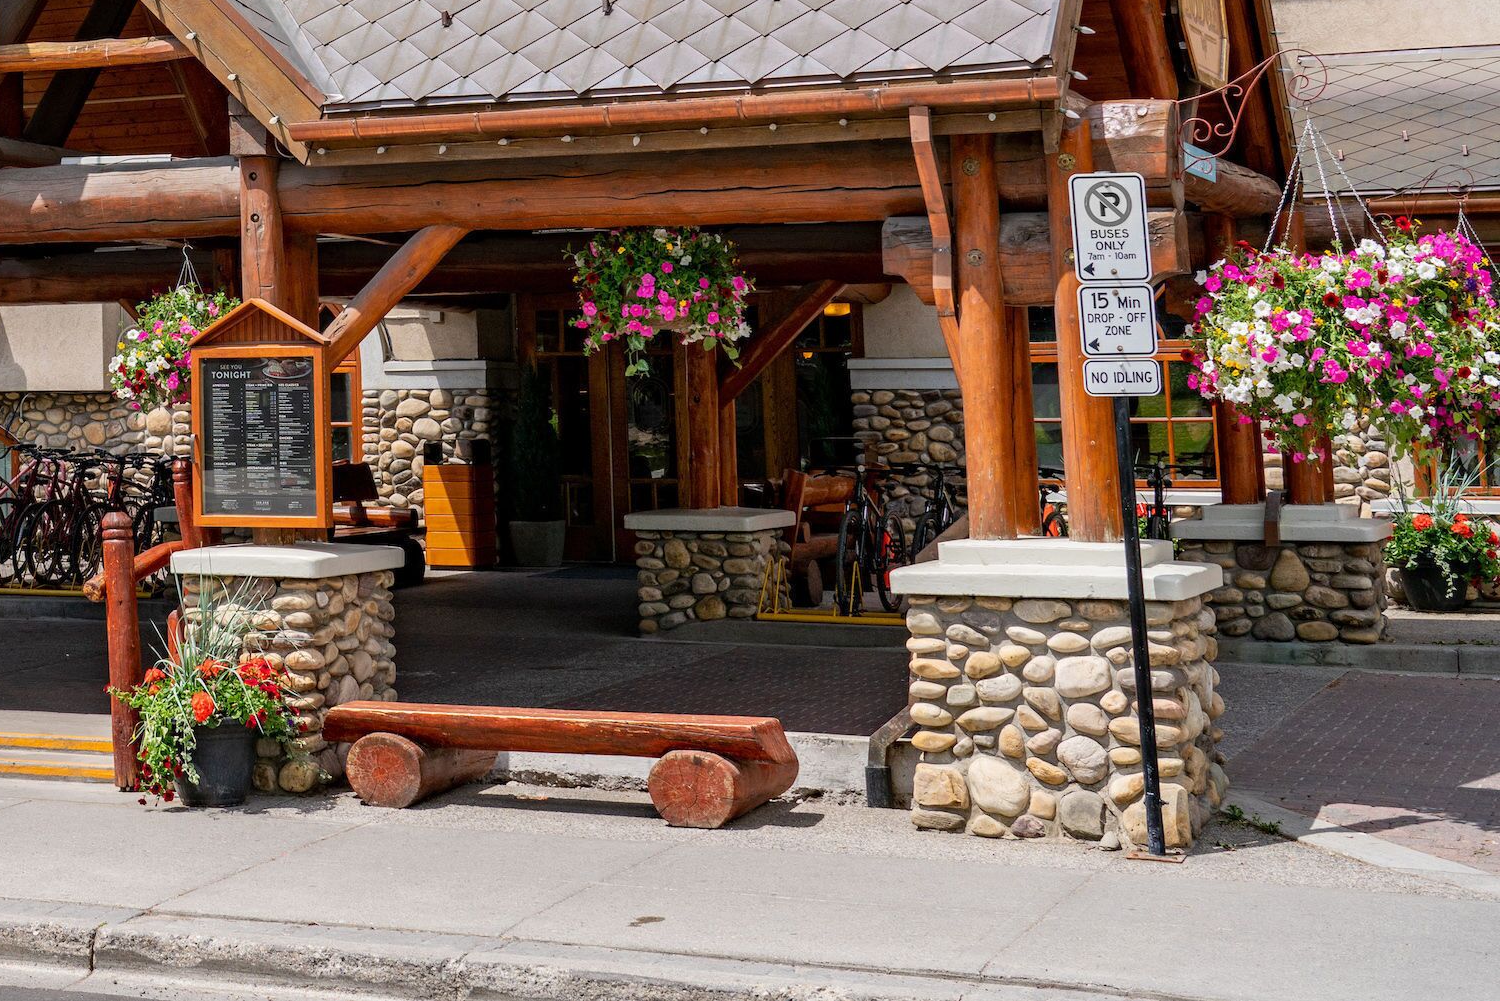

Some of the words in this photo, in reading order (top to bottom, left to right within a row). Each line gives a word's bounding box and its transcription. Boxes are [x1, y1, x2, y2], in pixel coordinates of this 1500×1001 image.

[1090, 229, 1129, 239] BUSES
[1095, 241, 1126, 250] ONLY
[1087, 252, 1105, 260] 7am
[1115, 251, 1137, 260] 10am
[1091, 292, 1109, 309] 15
[1117, 296, 1141, 308] Min
[1087, 313, 1115, 323] DROP
[1127, 312, 1147, 323] OFF
[1105, 325, 1132, 336] ZONE
[211, 371, 252, 379] TONIGHT
[1091, 371, 1109, 384] NO
[1113, 371, 1153, 384] IDLING
